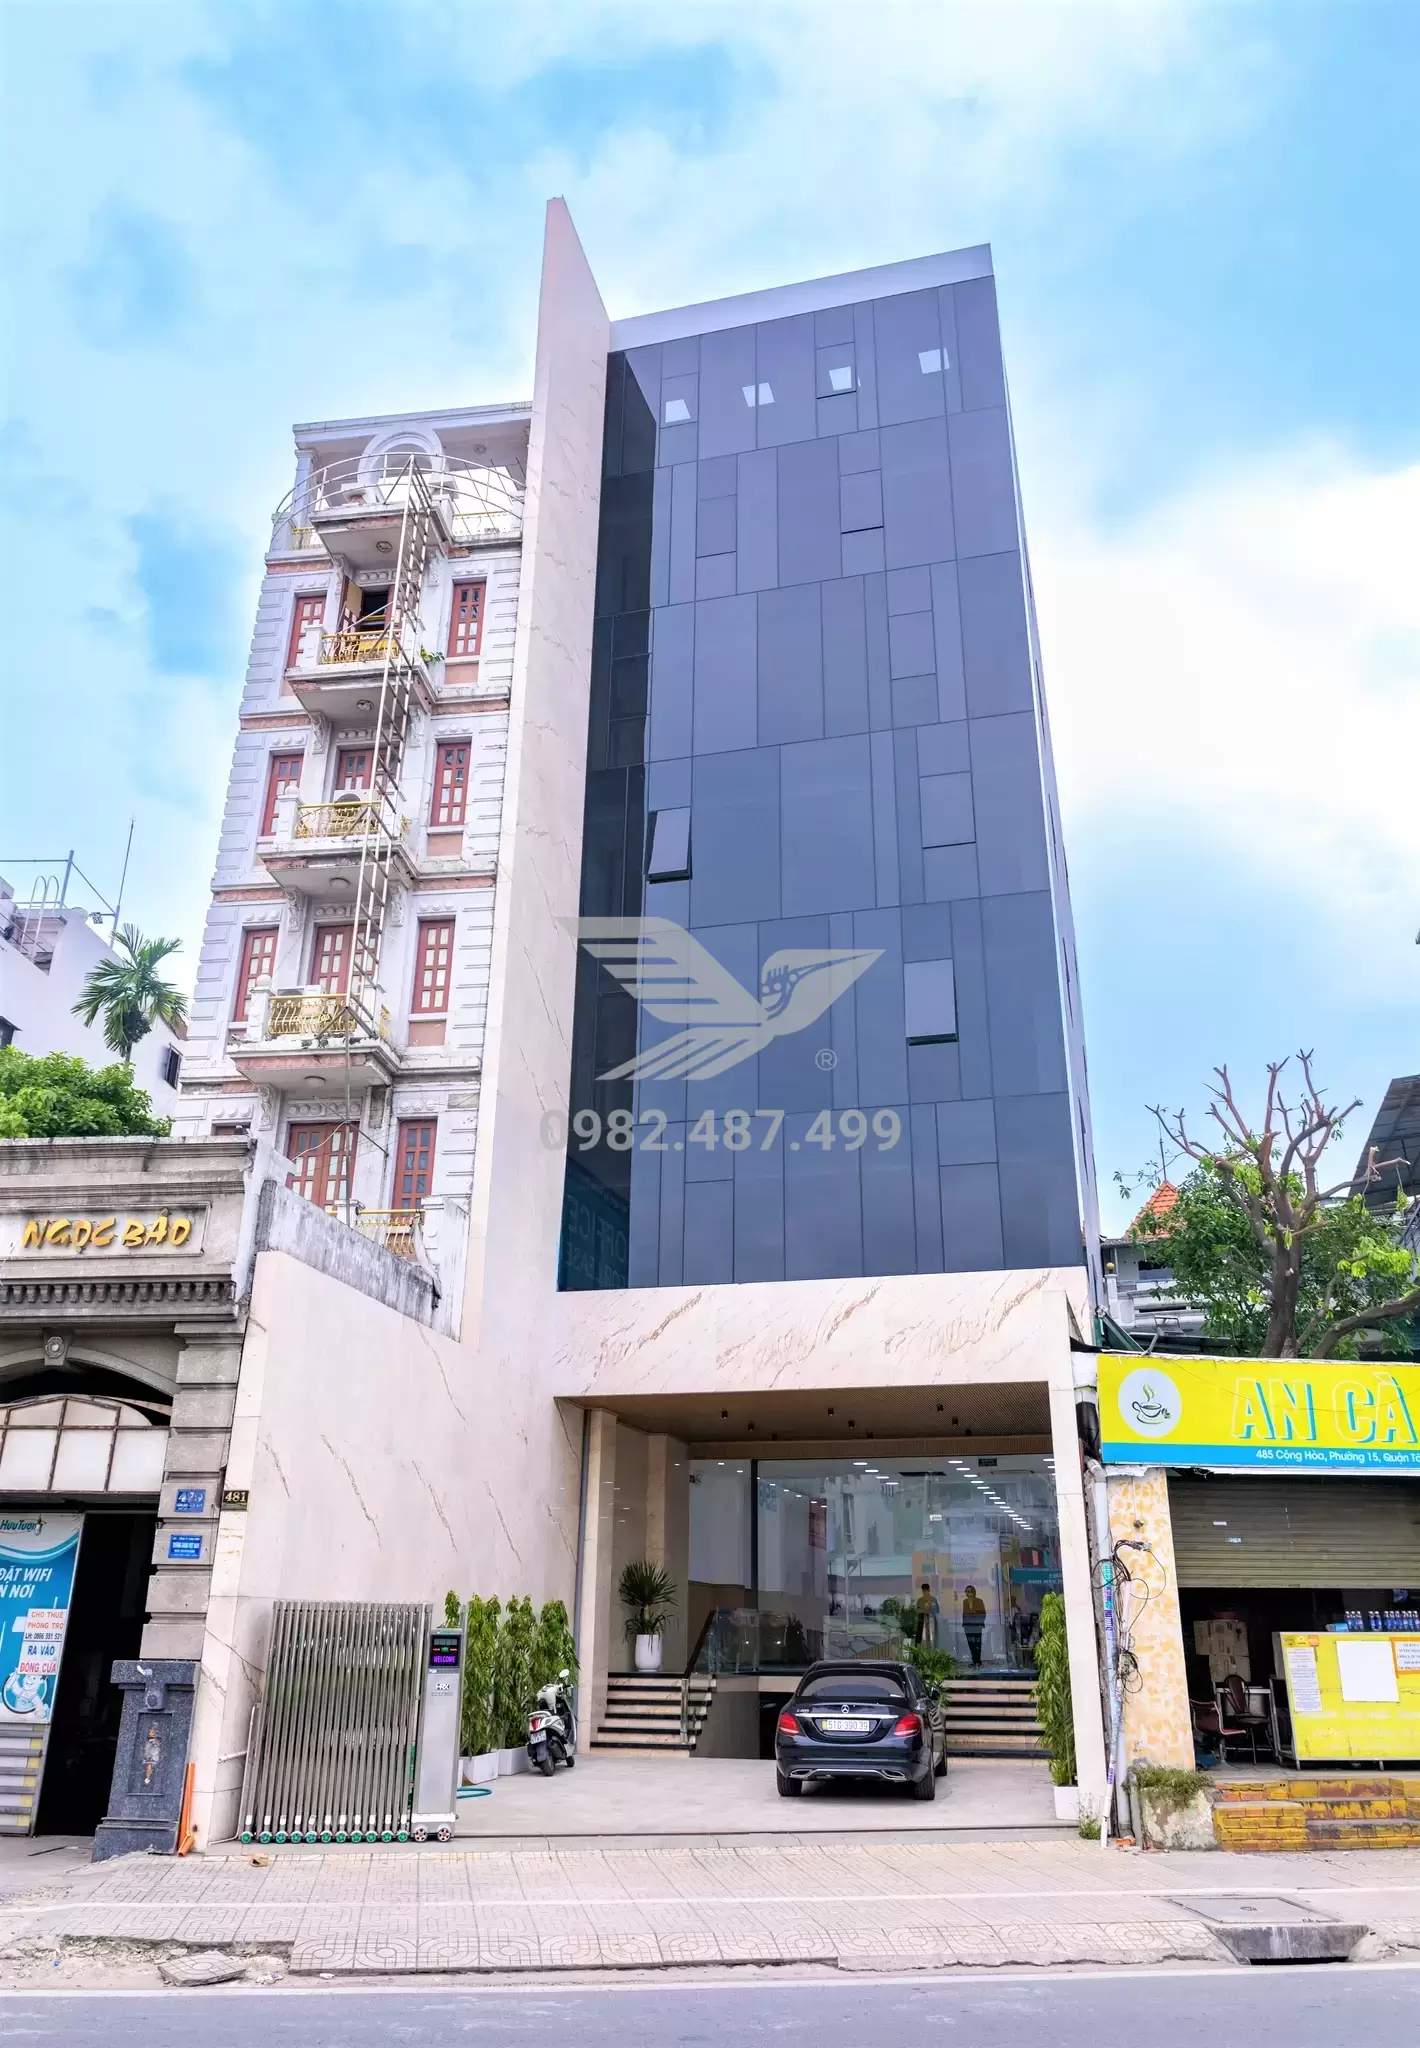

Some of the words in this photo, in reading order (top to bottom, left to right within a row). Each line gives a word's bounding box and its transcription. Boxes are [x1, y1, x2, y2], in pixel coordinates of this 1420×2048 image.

[22, 1217, 117, 1253] NGỌC
[122, 1207, 192, 1247] BẢO
[1231, 1377, 1317, 1441] AN
[1256, 1449, 1273, 1459] 485
[1276, 1450, 1302, 1463] Cộng
[1367, 1452, 1381, 1463] 15,
[225, 1491, 247, 1502] 481
[23, 1567, 53, 1582] WIFI
[27, 1645, 37, 1656] RA
